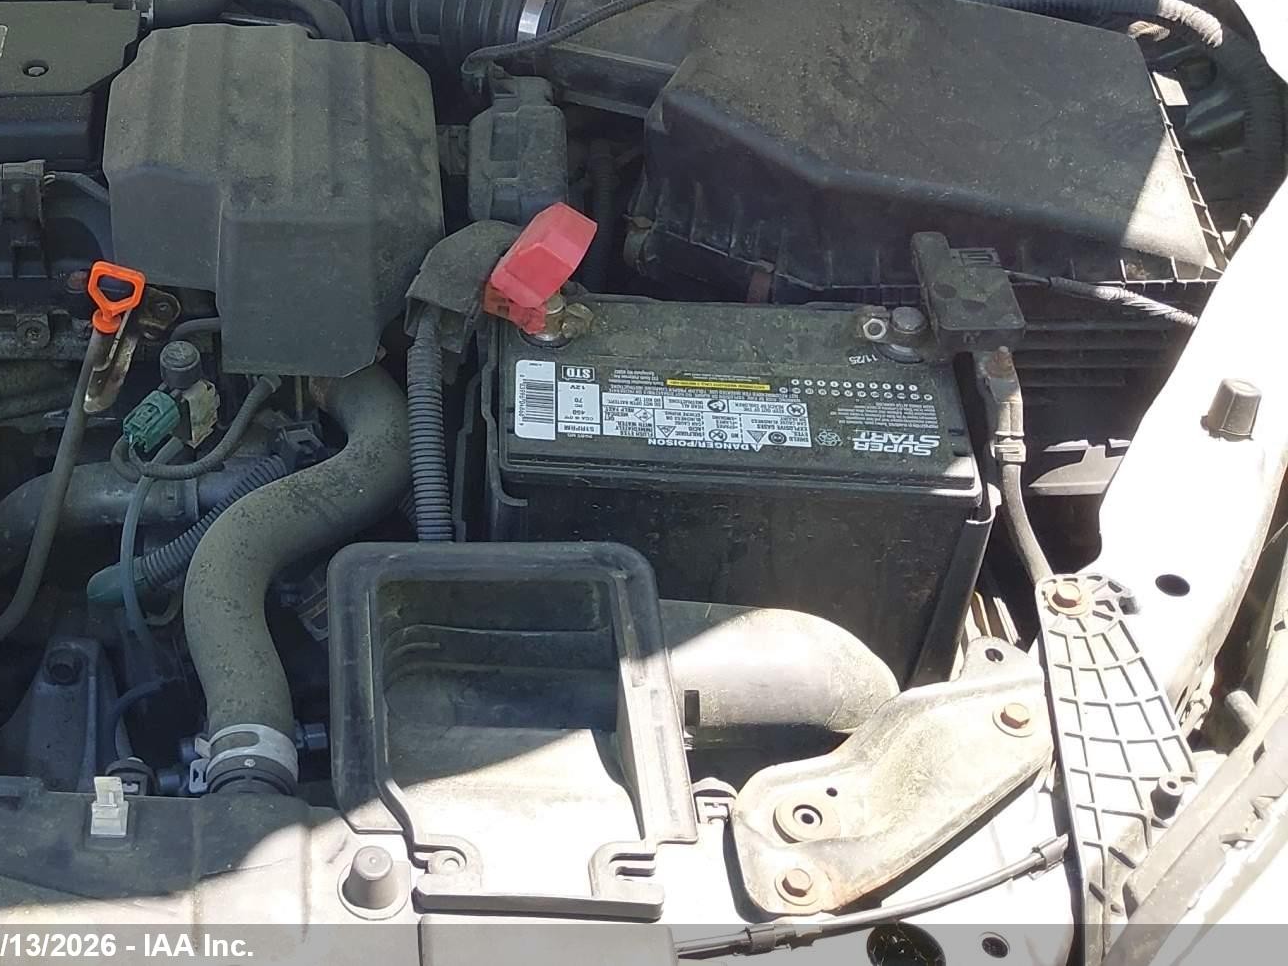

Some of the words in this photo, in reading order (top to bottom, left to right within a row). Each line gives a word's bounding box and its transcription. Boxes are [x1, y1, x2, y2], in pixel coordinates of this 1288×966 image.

[848, 354, 878, 364] 11/25
[566, 367, 590, 378] STD
[852, 431, 940, 446] START
[647, 439, 749, 450] DANGER/POISON
[852, 442, 930, 455] SUPER
